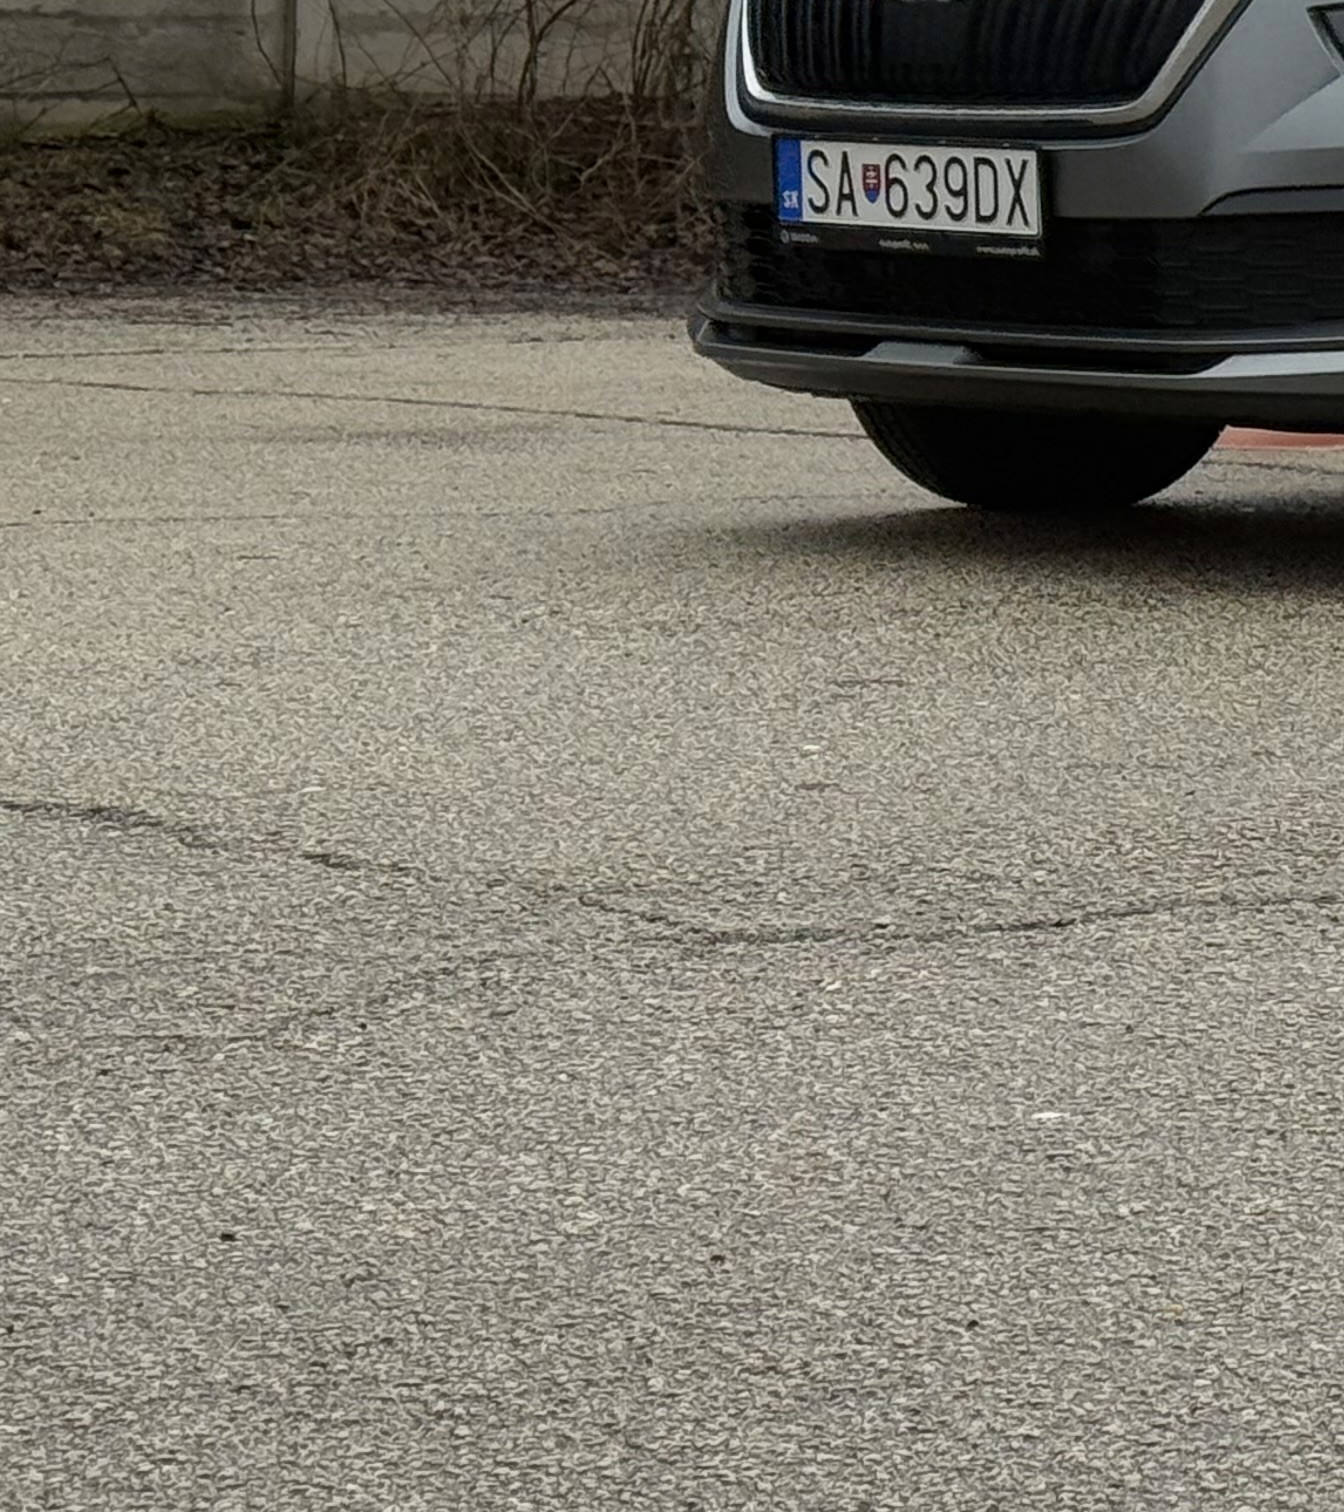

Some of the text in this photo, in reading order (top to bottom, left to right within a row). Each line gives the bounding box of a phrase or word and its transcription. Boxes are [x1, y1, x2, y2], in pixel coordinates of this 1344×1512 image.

[782, 190, 799, 209] SK
[807, 149, 1030, 227] SA 639DX
